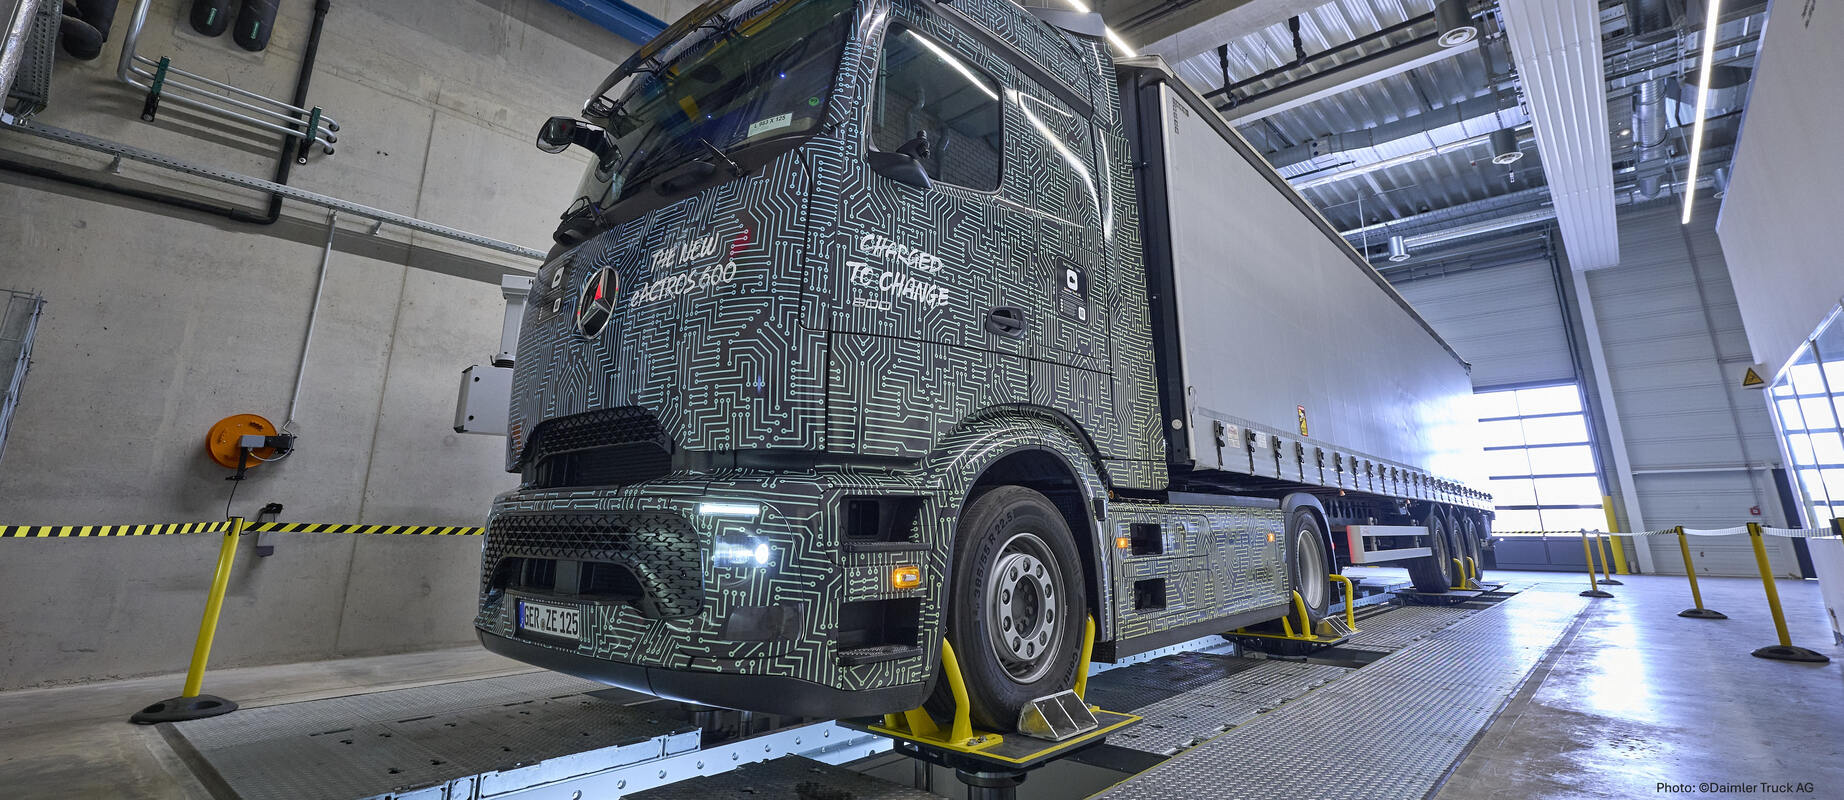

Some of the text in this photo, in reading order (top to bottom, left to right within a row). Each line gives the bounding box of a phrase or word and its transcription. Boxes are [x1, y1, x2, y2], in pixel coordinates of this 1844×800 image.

[650, 232, 720, 273] THE NEW
[860, 233, 943, 273] CHARGED
[630, 261, 737, 307] eACTROS 600
[845, 260, 949, 308] TO CHANGE
[988, 533, 996, 545] R
[994, 512, 1013, 535] 22.5
[524, 605, 578, 635] GER ZE 125
